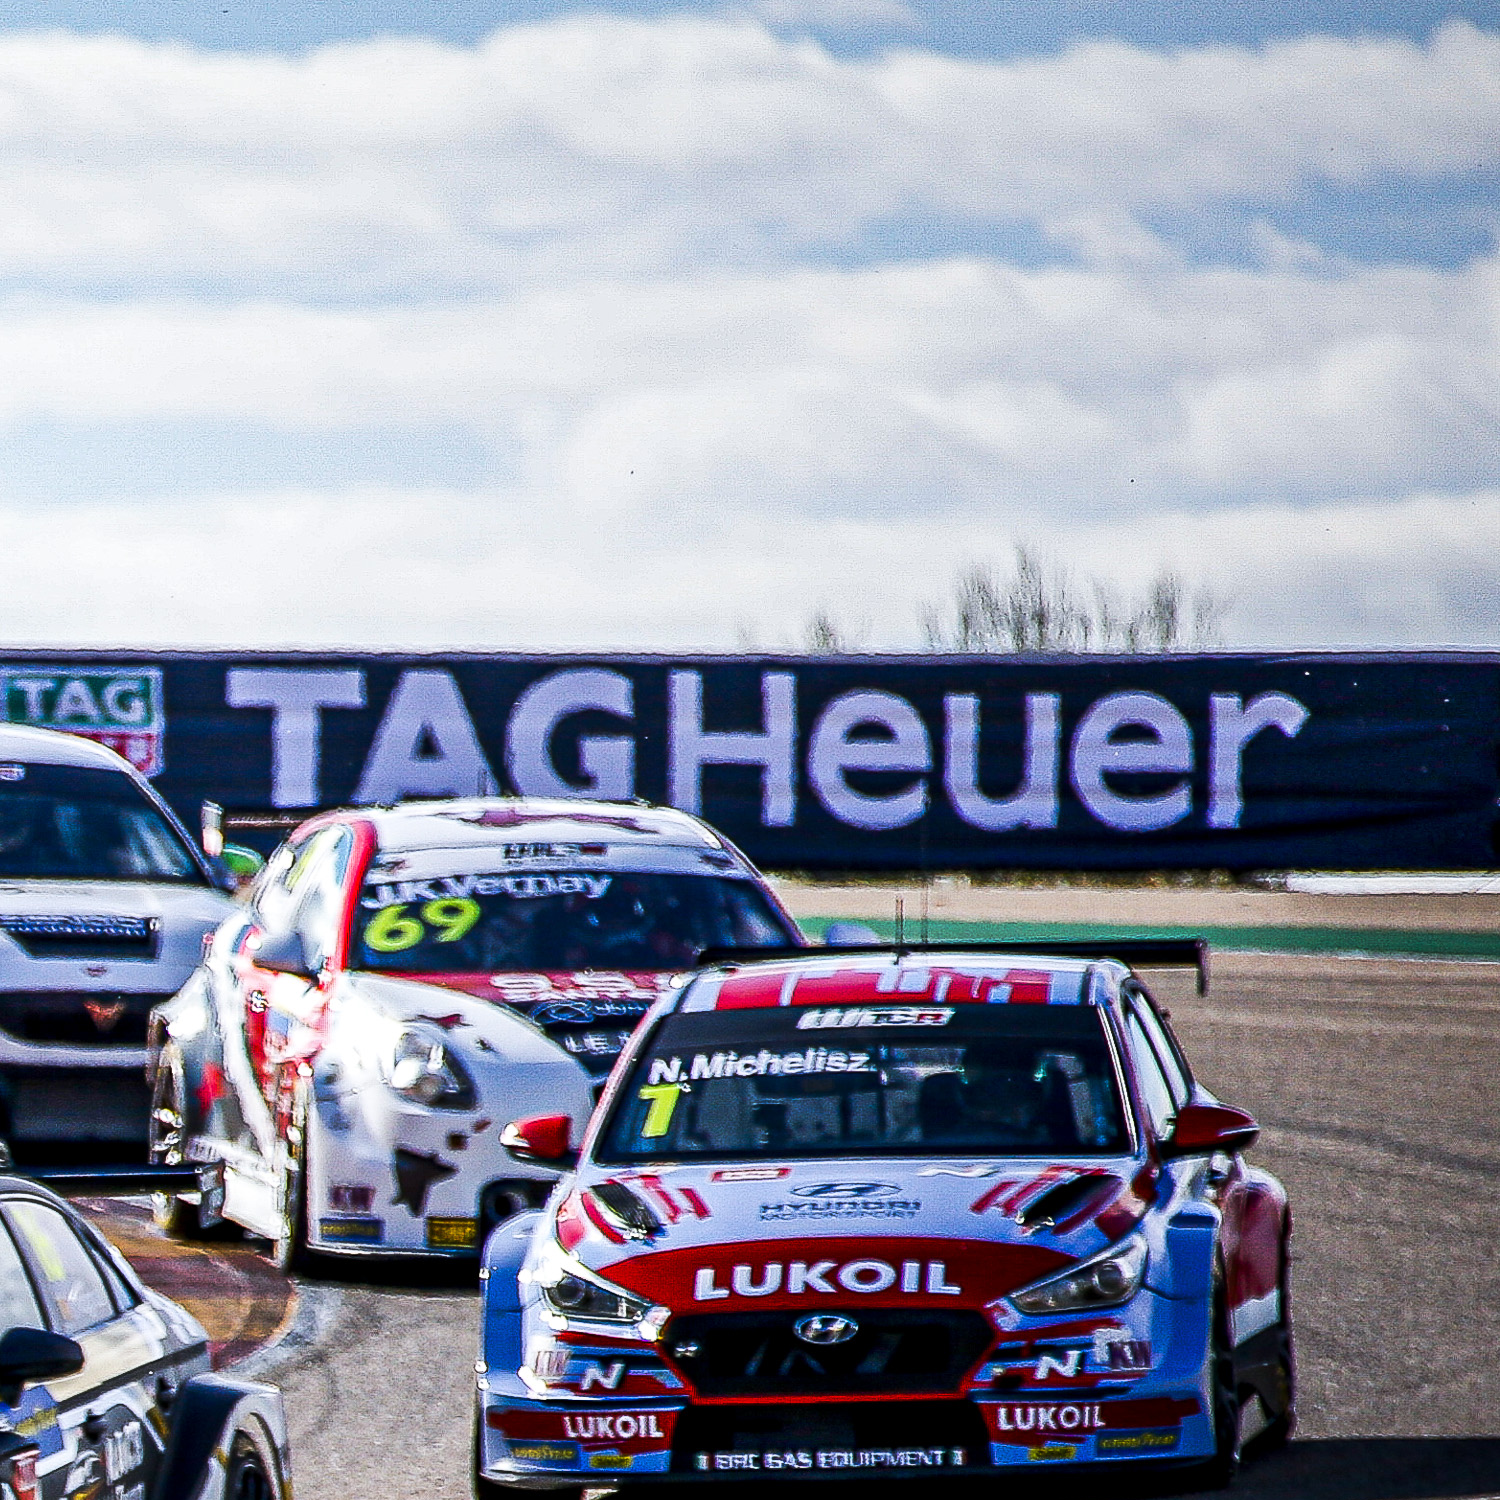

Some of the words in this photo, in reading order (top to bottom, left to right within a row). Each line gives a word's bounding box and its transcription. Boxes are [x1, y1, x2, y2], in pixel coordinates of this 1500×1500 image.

[12, 678, 147, 724] TAG
[362, 897, 481, 952] 69
[639, 1083, 681, 1139] 1
[693, 1258, 962, 1301] LUKOIL
[562, 1414, 665, 1439] LUKOIL
[997, 1404, 1106, 1431] LUKOIL
[763, 1451, 813, 1470] GAS
[816, 1449, 944, 1469] EQUIPMENT
